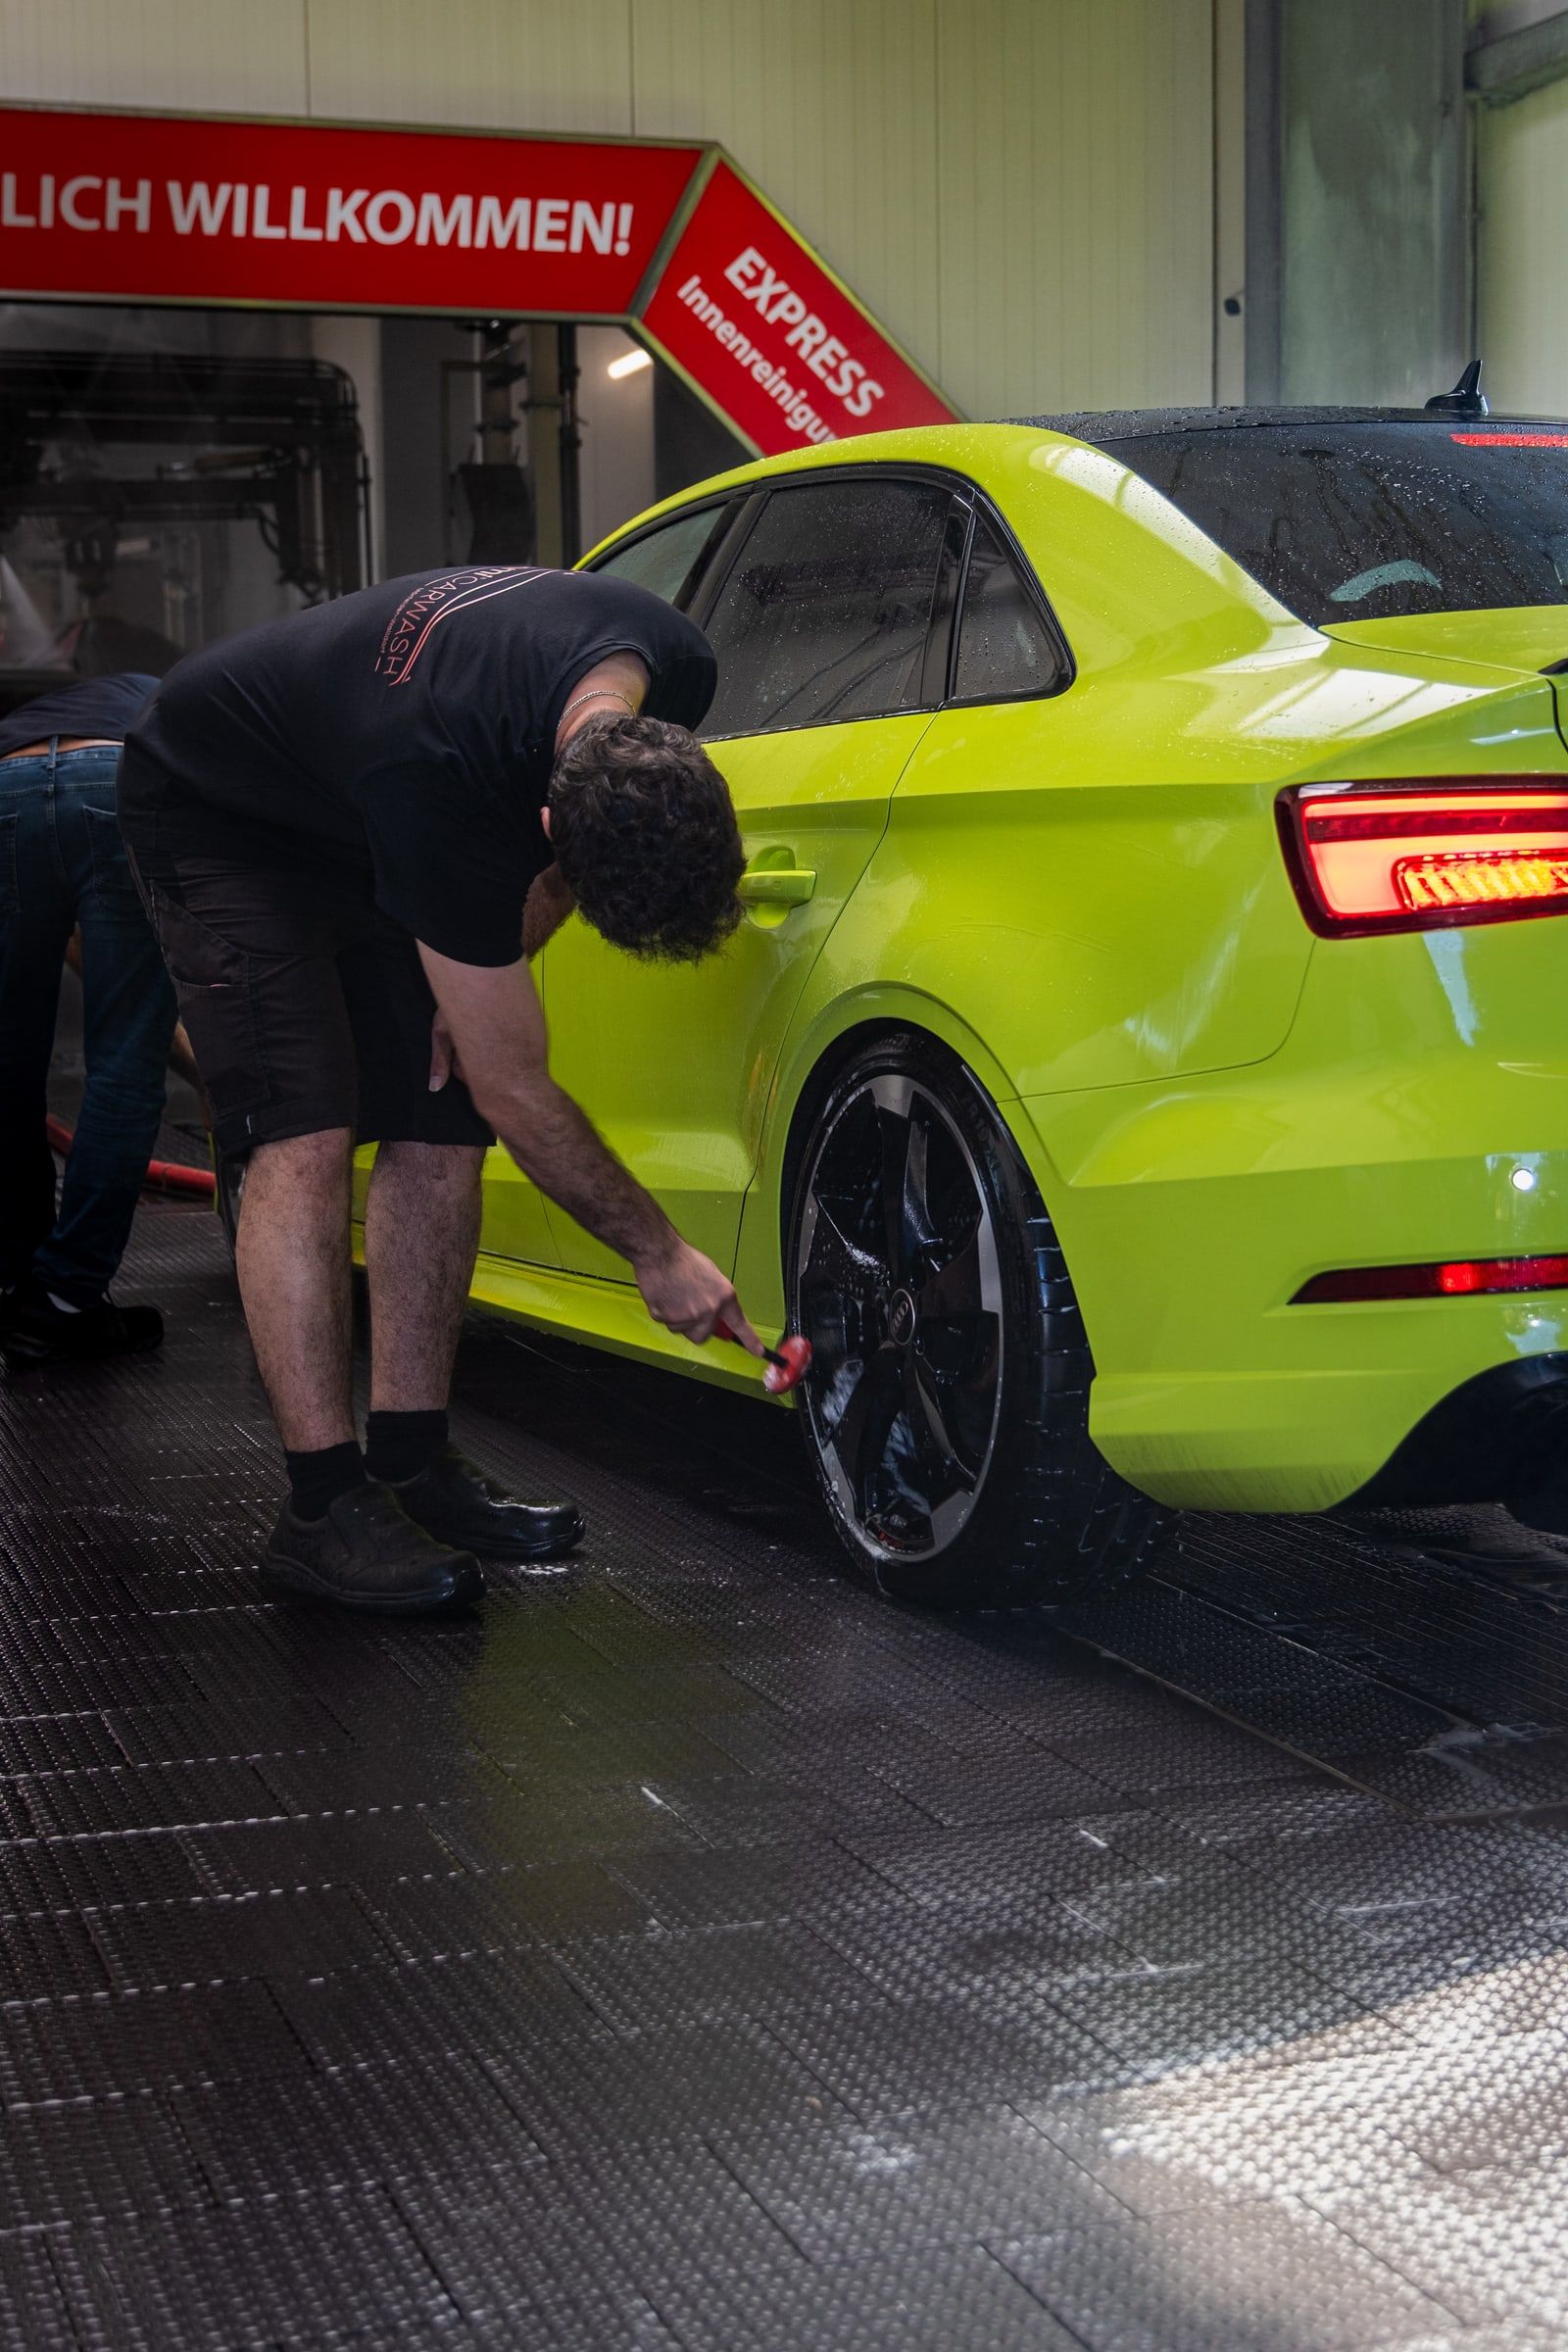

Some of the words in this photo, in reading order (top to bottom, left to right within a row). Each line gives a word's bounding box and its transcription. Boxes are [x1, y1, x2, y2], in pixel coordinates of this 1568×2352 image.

[2, 173, 151, 232] LICH
[167, 181, 634, 256] WILLKOMMEN!
[723, 246, 885, 416] EXPRESS
[383, 575, 477, 675] CARWASH
